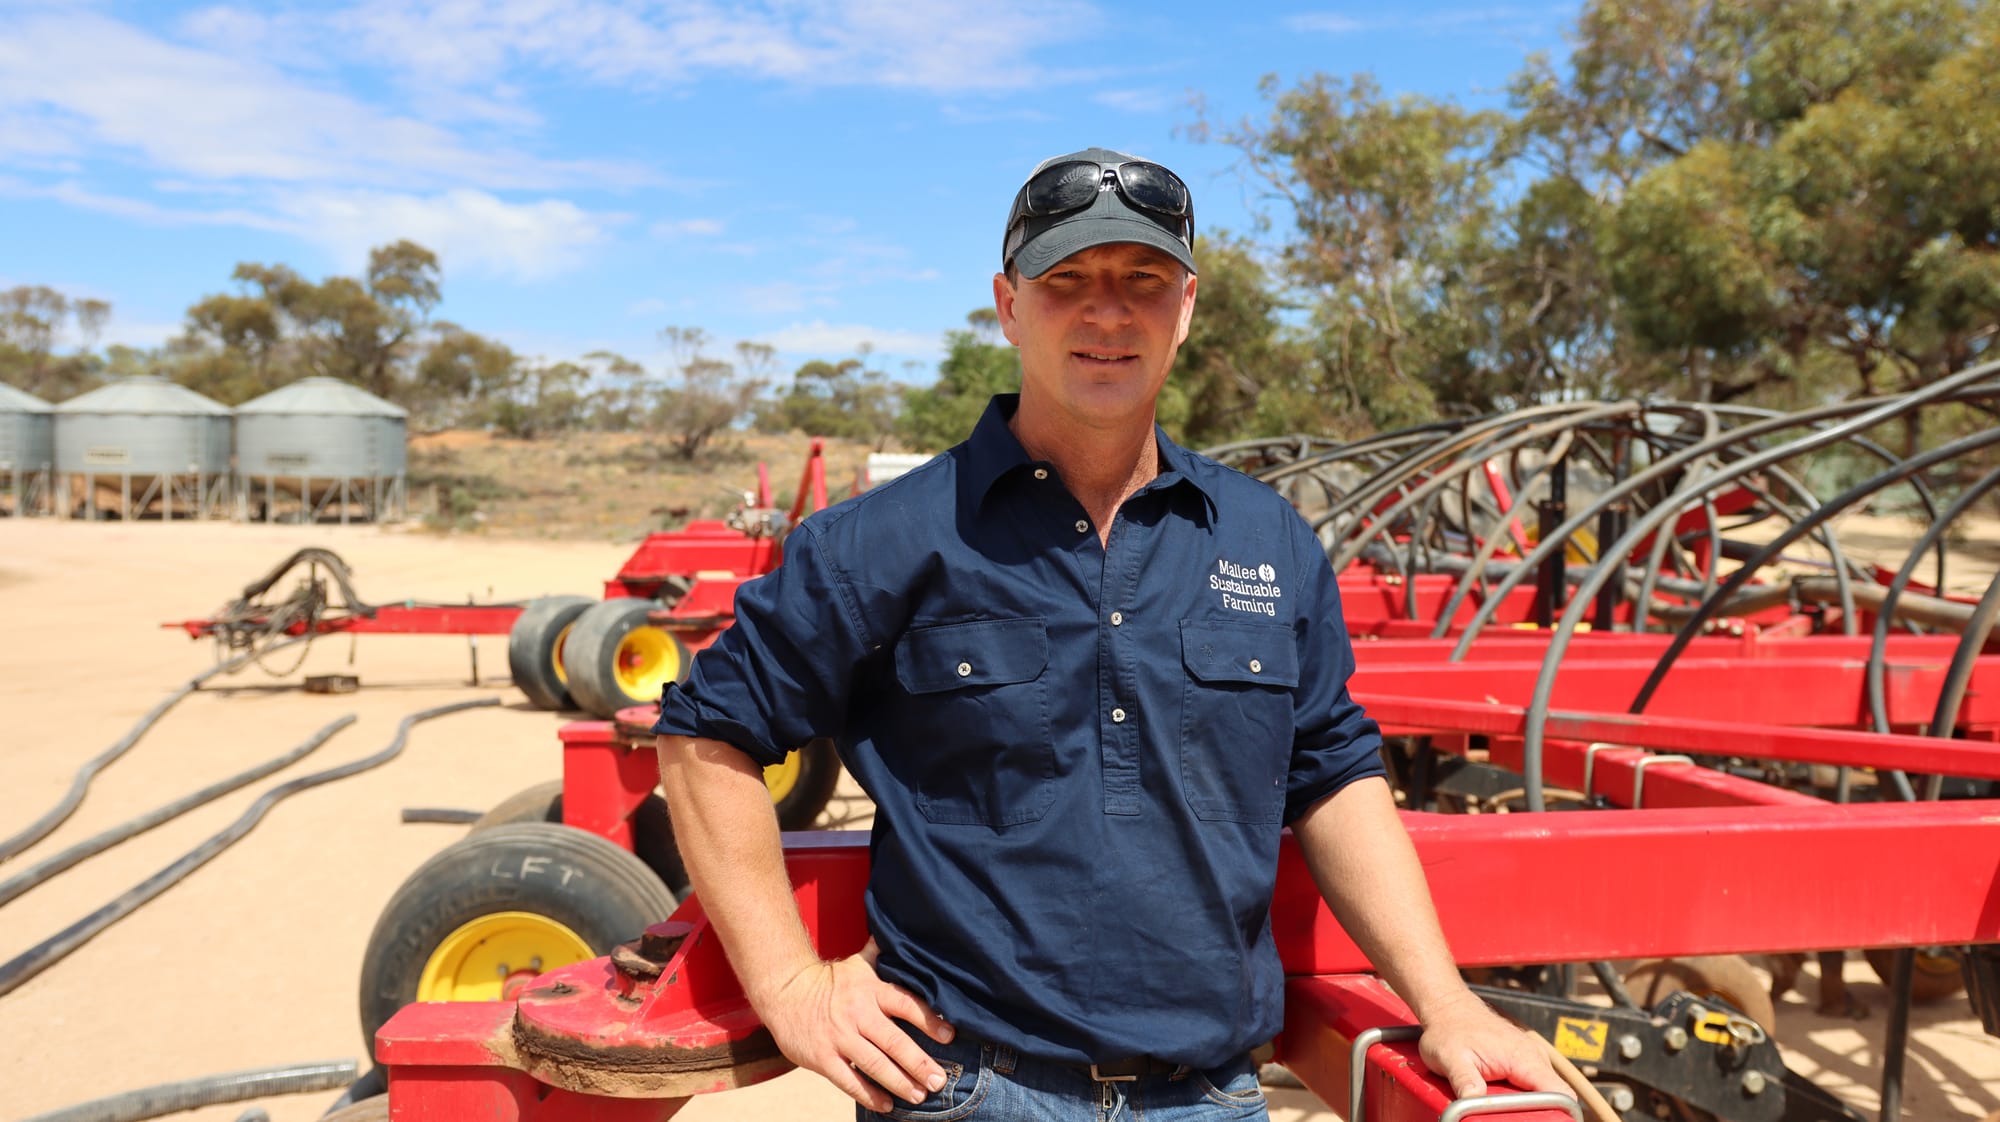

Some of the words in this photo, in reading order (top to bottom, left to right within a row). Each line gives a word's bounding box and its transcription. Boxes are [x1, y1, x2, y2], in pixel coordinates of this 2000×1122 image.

[1219, 560, 1257, 580] Mallee
[1210, 574, 1281, 597] Sustainable
[1222, 594, 1275, 616] Farming
